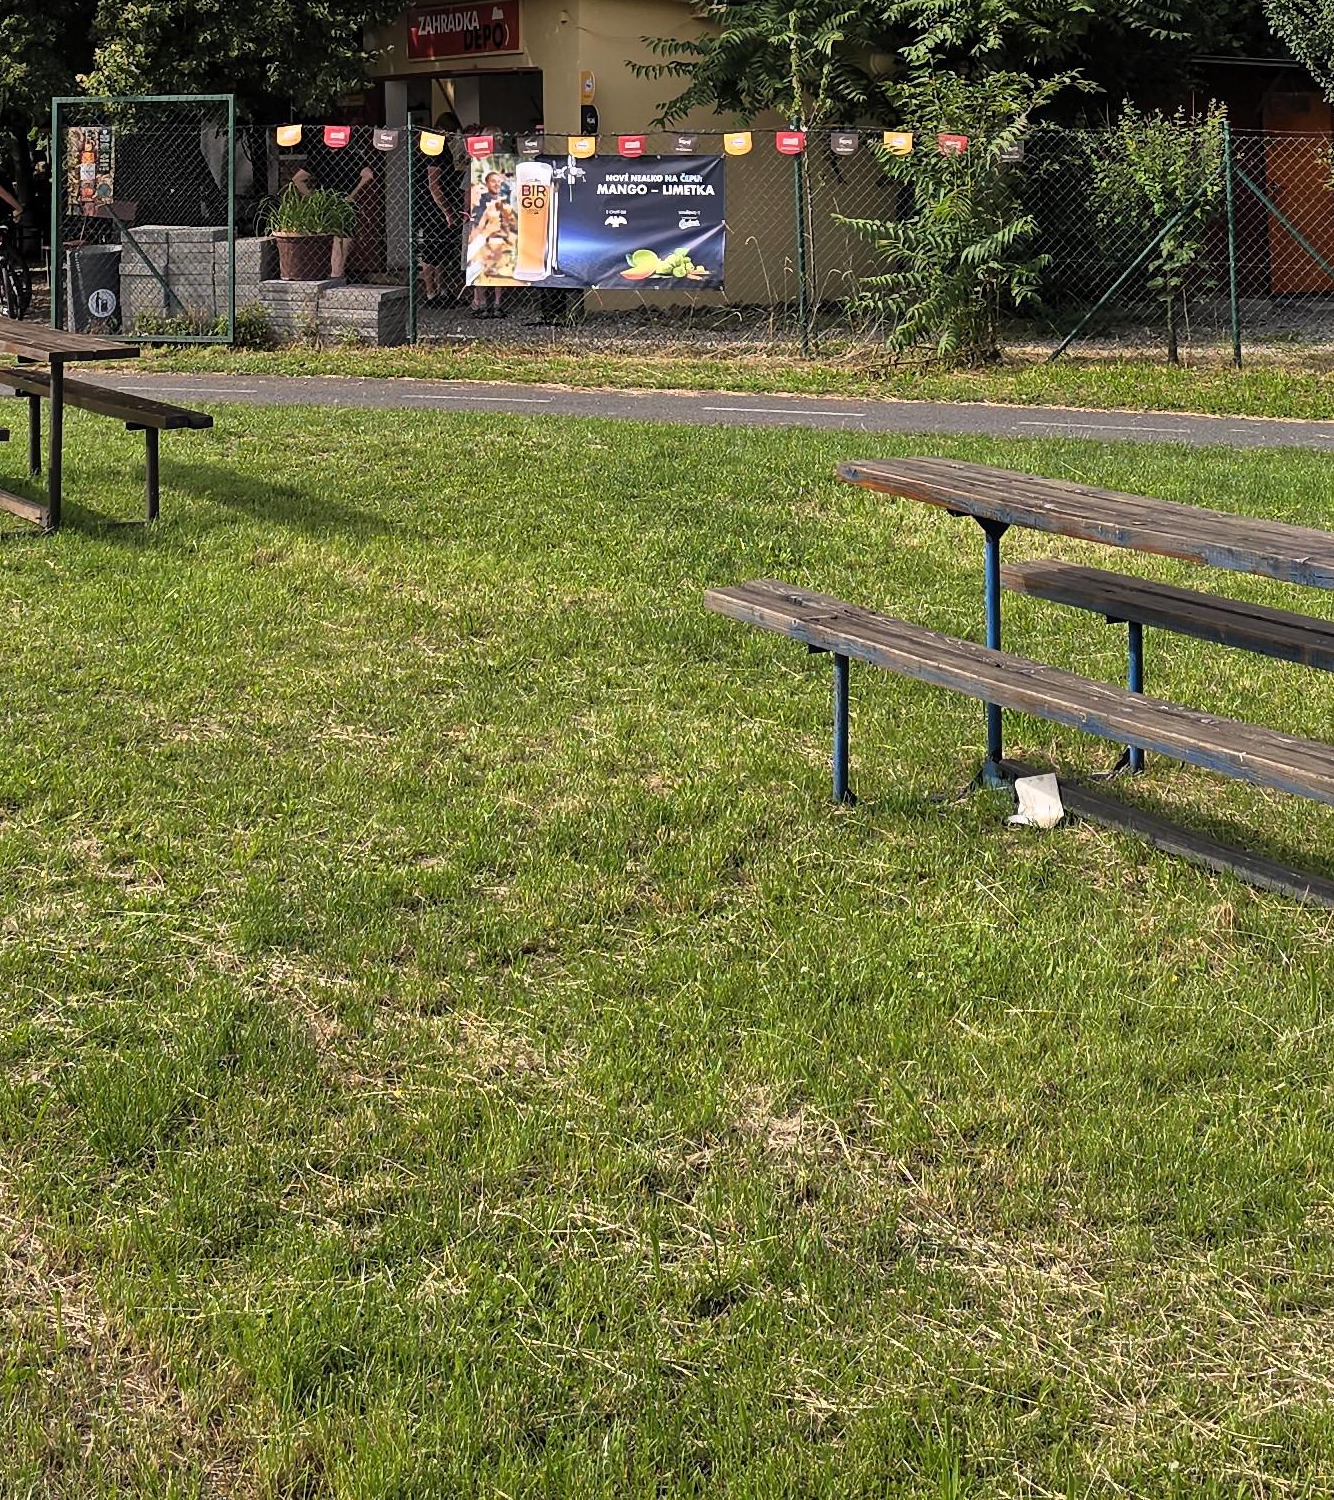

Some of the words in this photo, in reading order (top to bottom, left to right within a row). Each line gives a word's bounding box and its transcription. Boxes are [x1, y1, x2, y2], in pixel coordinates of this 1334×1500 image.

[464, 22, 504, 51] DEPO
[665, 174, 678, 182] NA
[522, 185, 546, 196] BIR
[596, 183, 648, 195] MANGO
[662, 184, 716, 196] LIMETKA
[521, 196, 545, 208] GO
